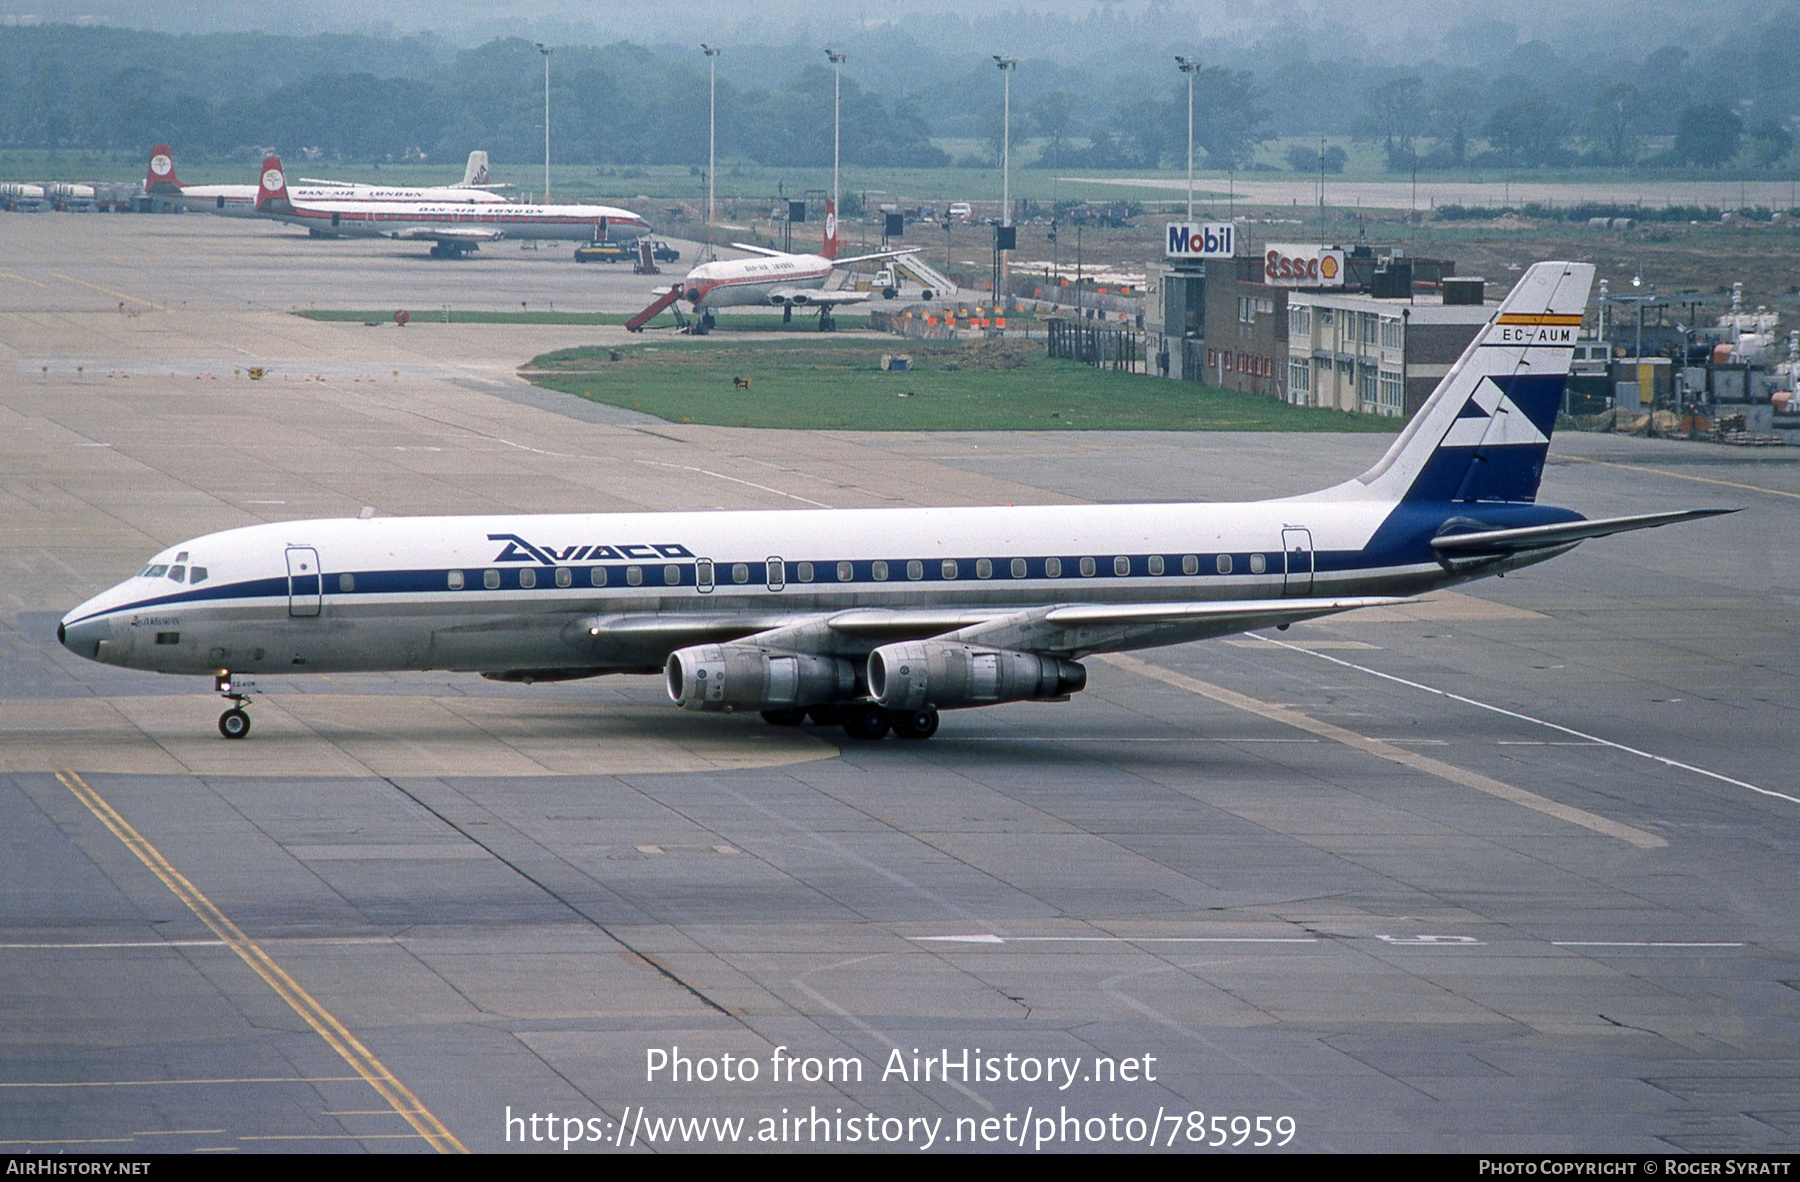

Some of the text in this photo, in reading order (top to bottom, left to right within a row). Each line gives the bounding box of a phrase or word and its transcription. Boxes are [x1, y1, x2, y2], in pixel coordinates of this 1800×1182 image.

[1169, 226, 1232, 253] Mobil
[1503, 328, 1570, 342] EC-AUM
[486, 533, 697, 566] AVIACO
